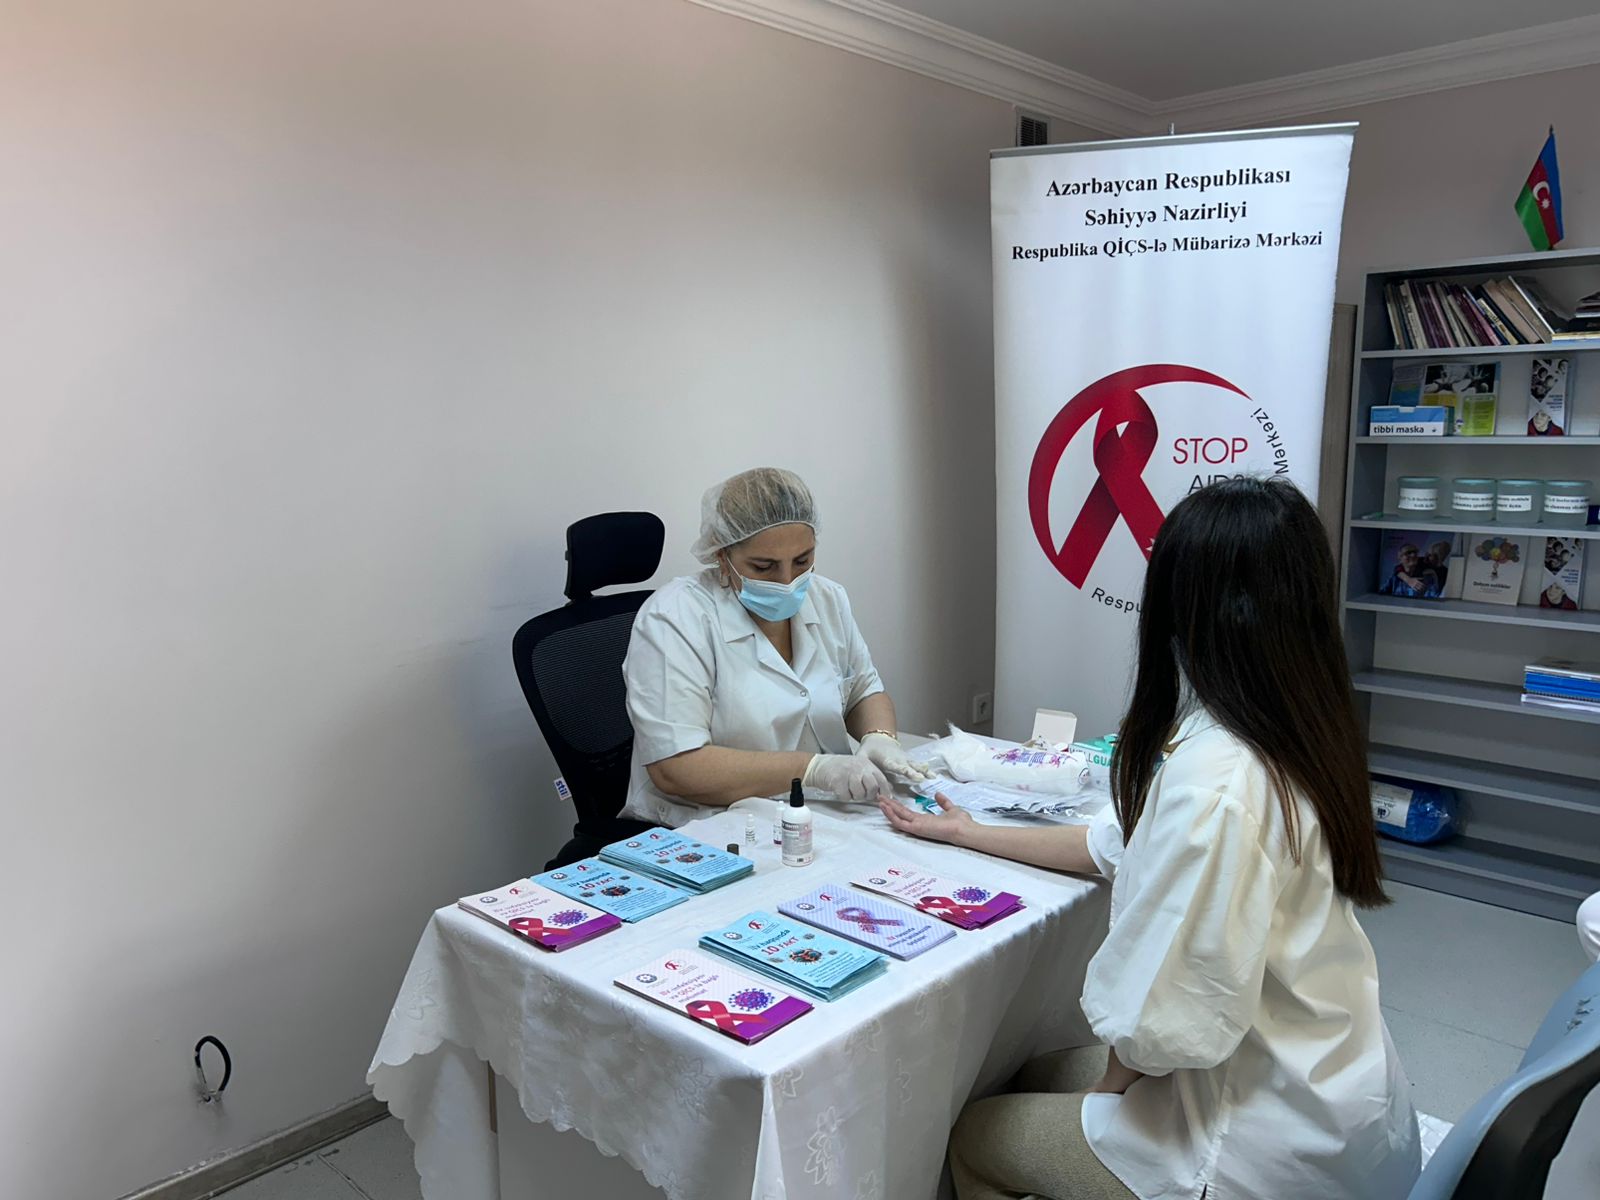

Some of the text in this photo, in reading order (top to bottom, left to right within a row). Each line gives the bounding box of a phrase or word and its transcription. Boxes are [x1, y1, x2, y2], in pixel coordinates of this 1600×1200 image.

[1046, 168, 1291, 197] Azərbaycan Respublikası
[1085, 201, 1248, 228] Səhiyyə Nazirliyi
[1012, 231, 1323, 261] Respublika QİÇS-lə Mübarizə Mərkəzi
[1373, 425, 1425, 434] tibbi maska
[1172, 436, 1248, 464] STOP
[1188, 474, 1244, 495] AI
[761, 945, 780, 955] 10
